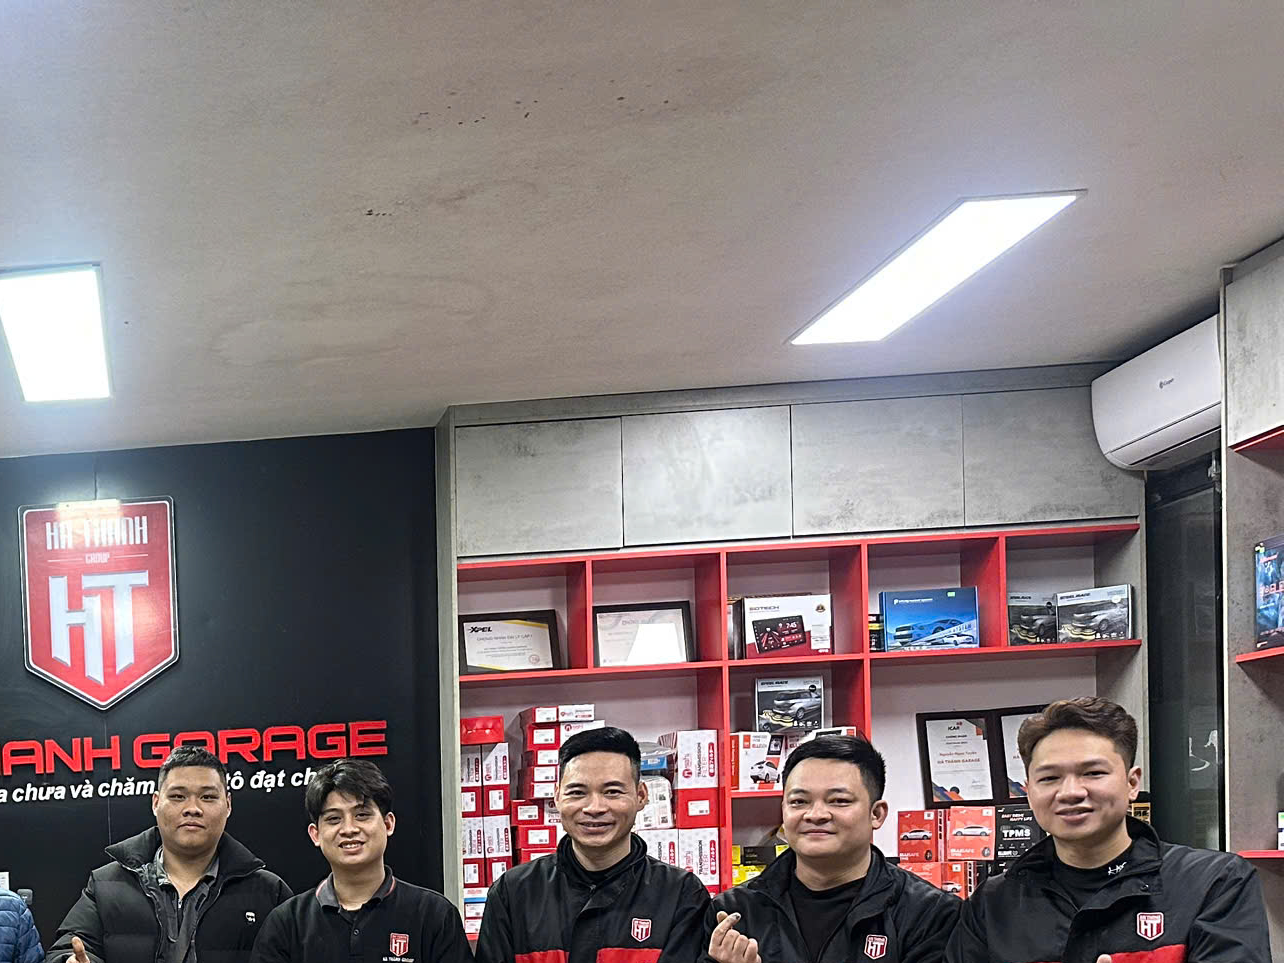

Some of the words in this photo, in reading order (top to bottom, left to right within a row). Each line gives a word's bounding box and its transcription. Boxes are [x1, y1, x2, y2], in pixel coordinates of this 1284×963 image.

[48, 570, 149, 686] HT
[133, 720, 389, 768] GARAGE
[70, 779, 94, 799] và
[97, 777, 155, 799] chăm
[249, 769, 285, 794] đạt
[1002, 829, 1031, 838] TPMS
[633, 923, 649, 940] HT
[1139, 919, 1161, 938] HT
[392, 938, 407, 955] HT
[867, 940, 885, 957] HT
